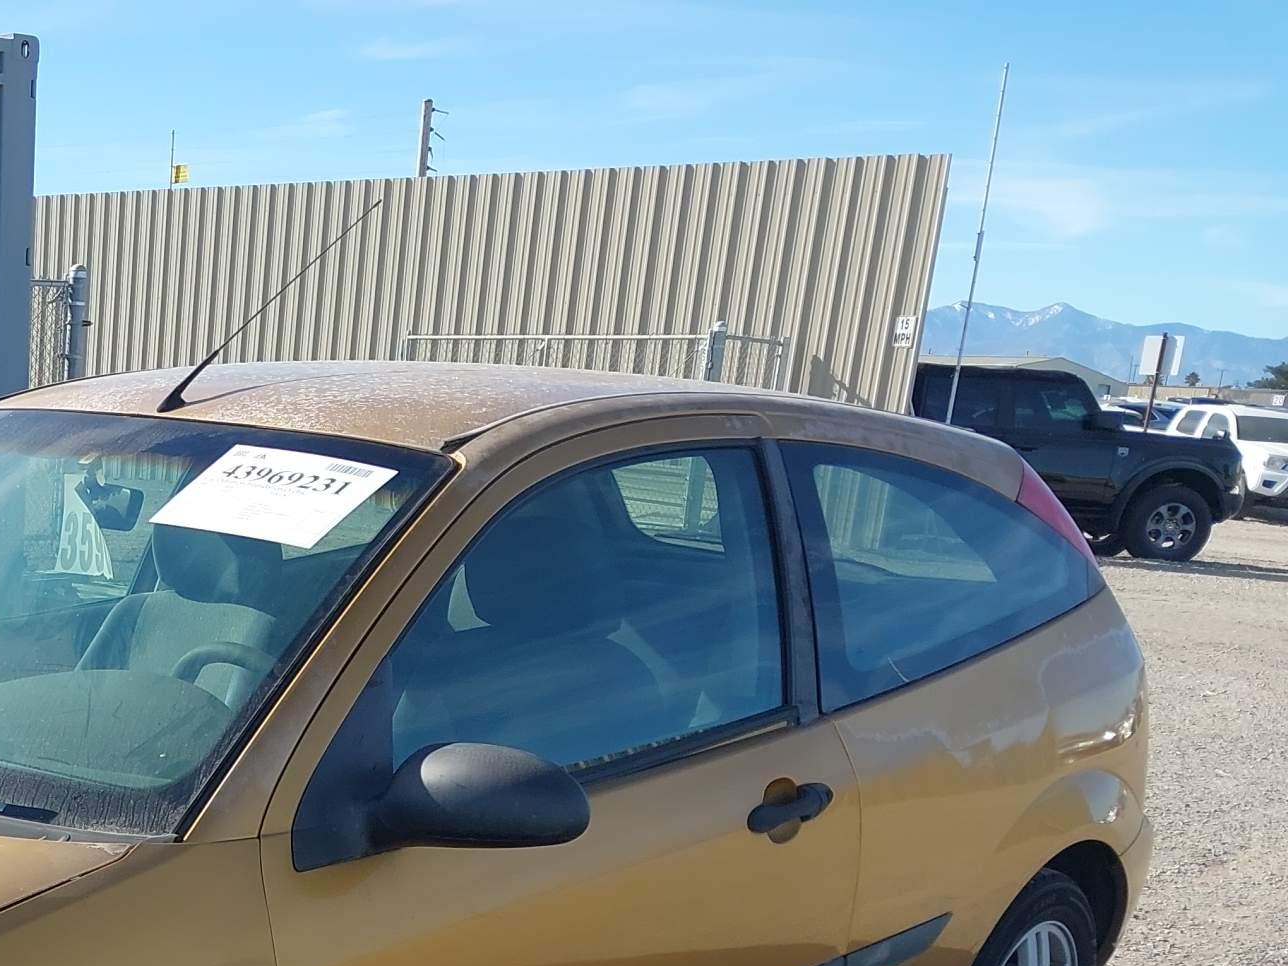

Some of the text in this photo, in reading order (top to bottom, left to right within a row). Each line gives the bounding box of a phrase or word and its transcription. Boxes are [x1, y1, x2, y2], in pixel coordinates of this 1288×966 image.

[901, 319, 910, 330] 15
[893, 333, 911, 345] MPH
[222, 464, 351, 495] 43969231
